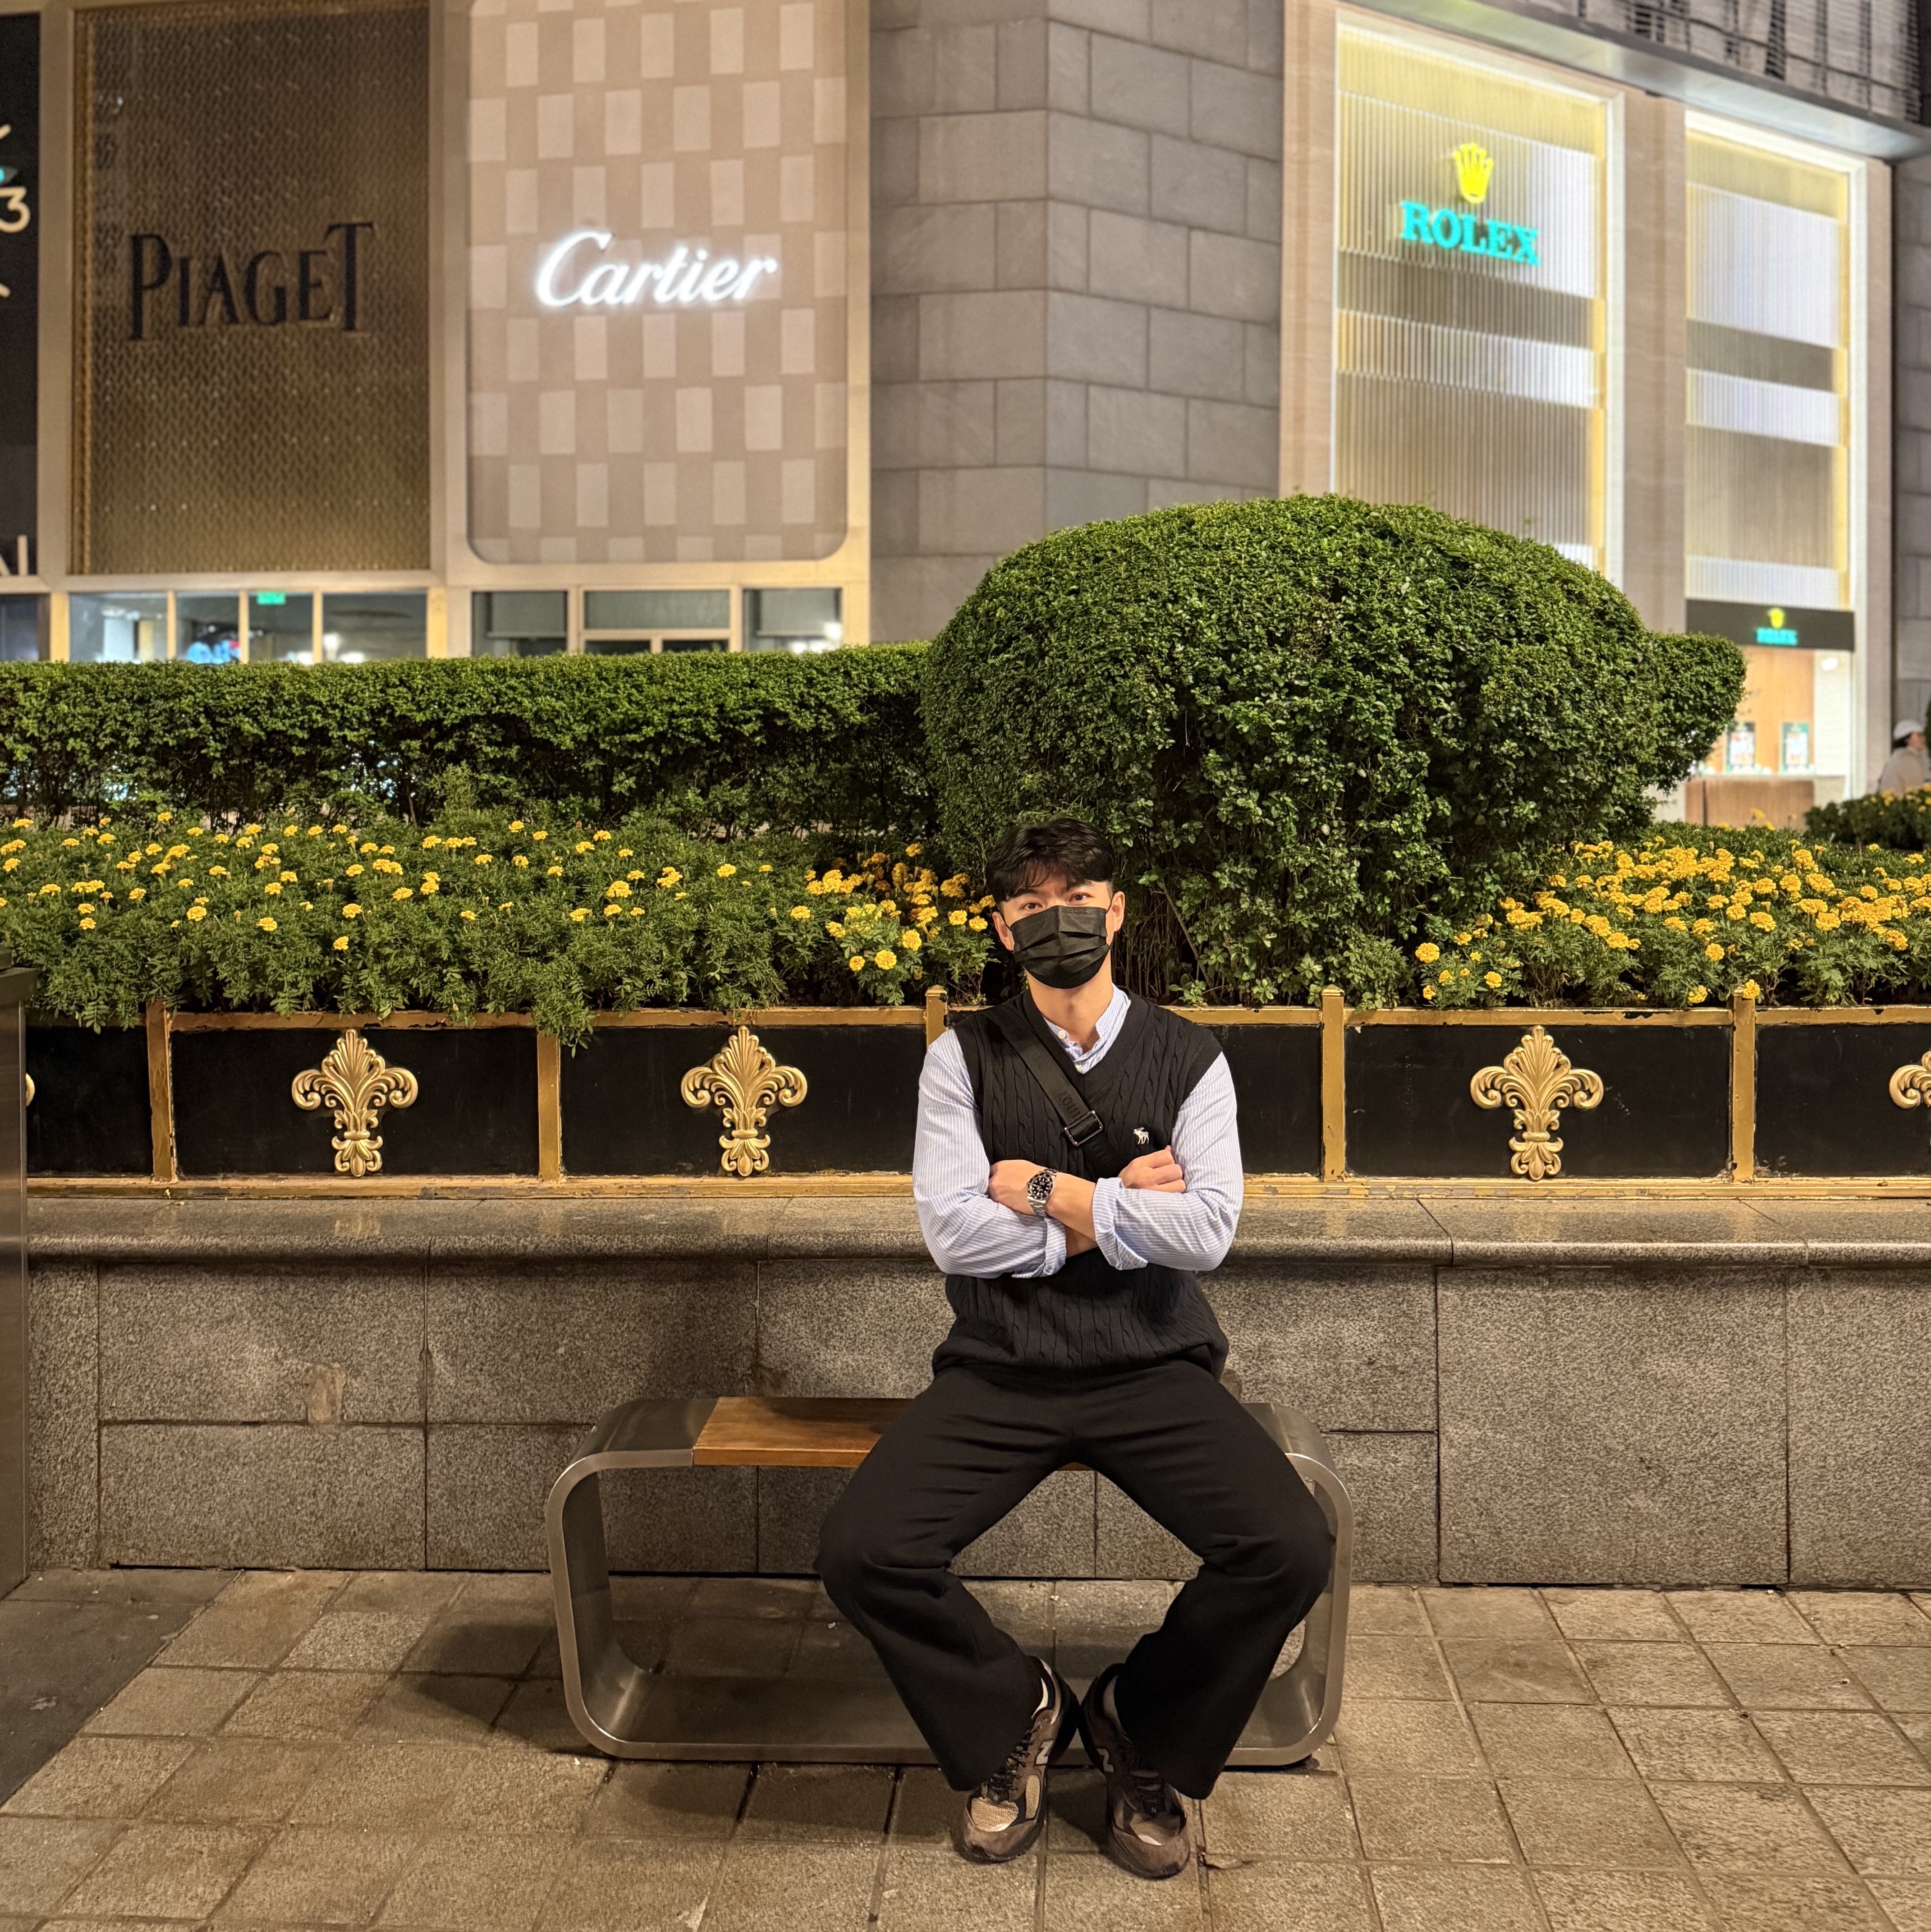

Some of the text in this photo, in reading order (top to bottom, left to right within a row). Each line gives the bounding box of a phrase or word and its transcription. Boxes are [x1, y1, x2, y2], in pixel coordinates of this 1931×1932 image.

[1401, 200, 1541, 266] ROLEX
[130, 222, 373, 340] PIAGET
[536, 231, 778, 307] Cartier
[1059, 1088, 1081, 1120] LOUI
